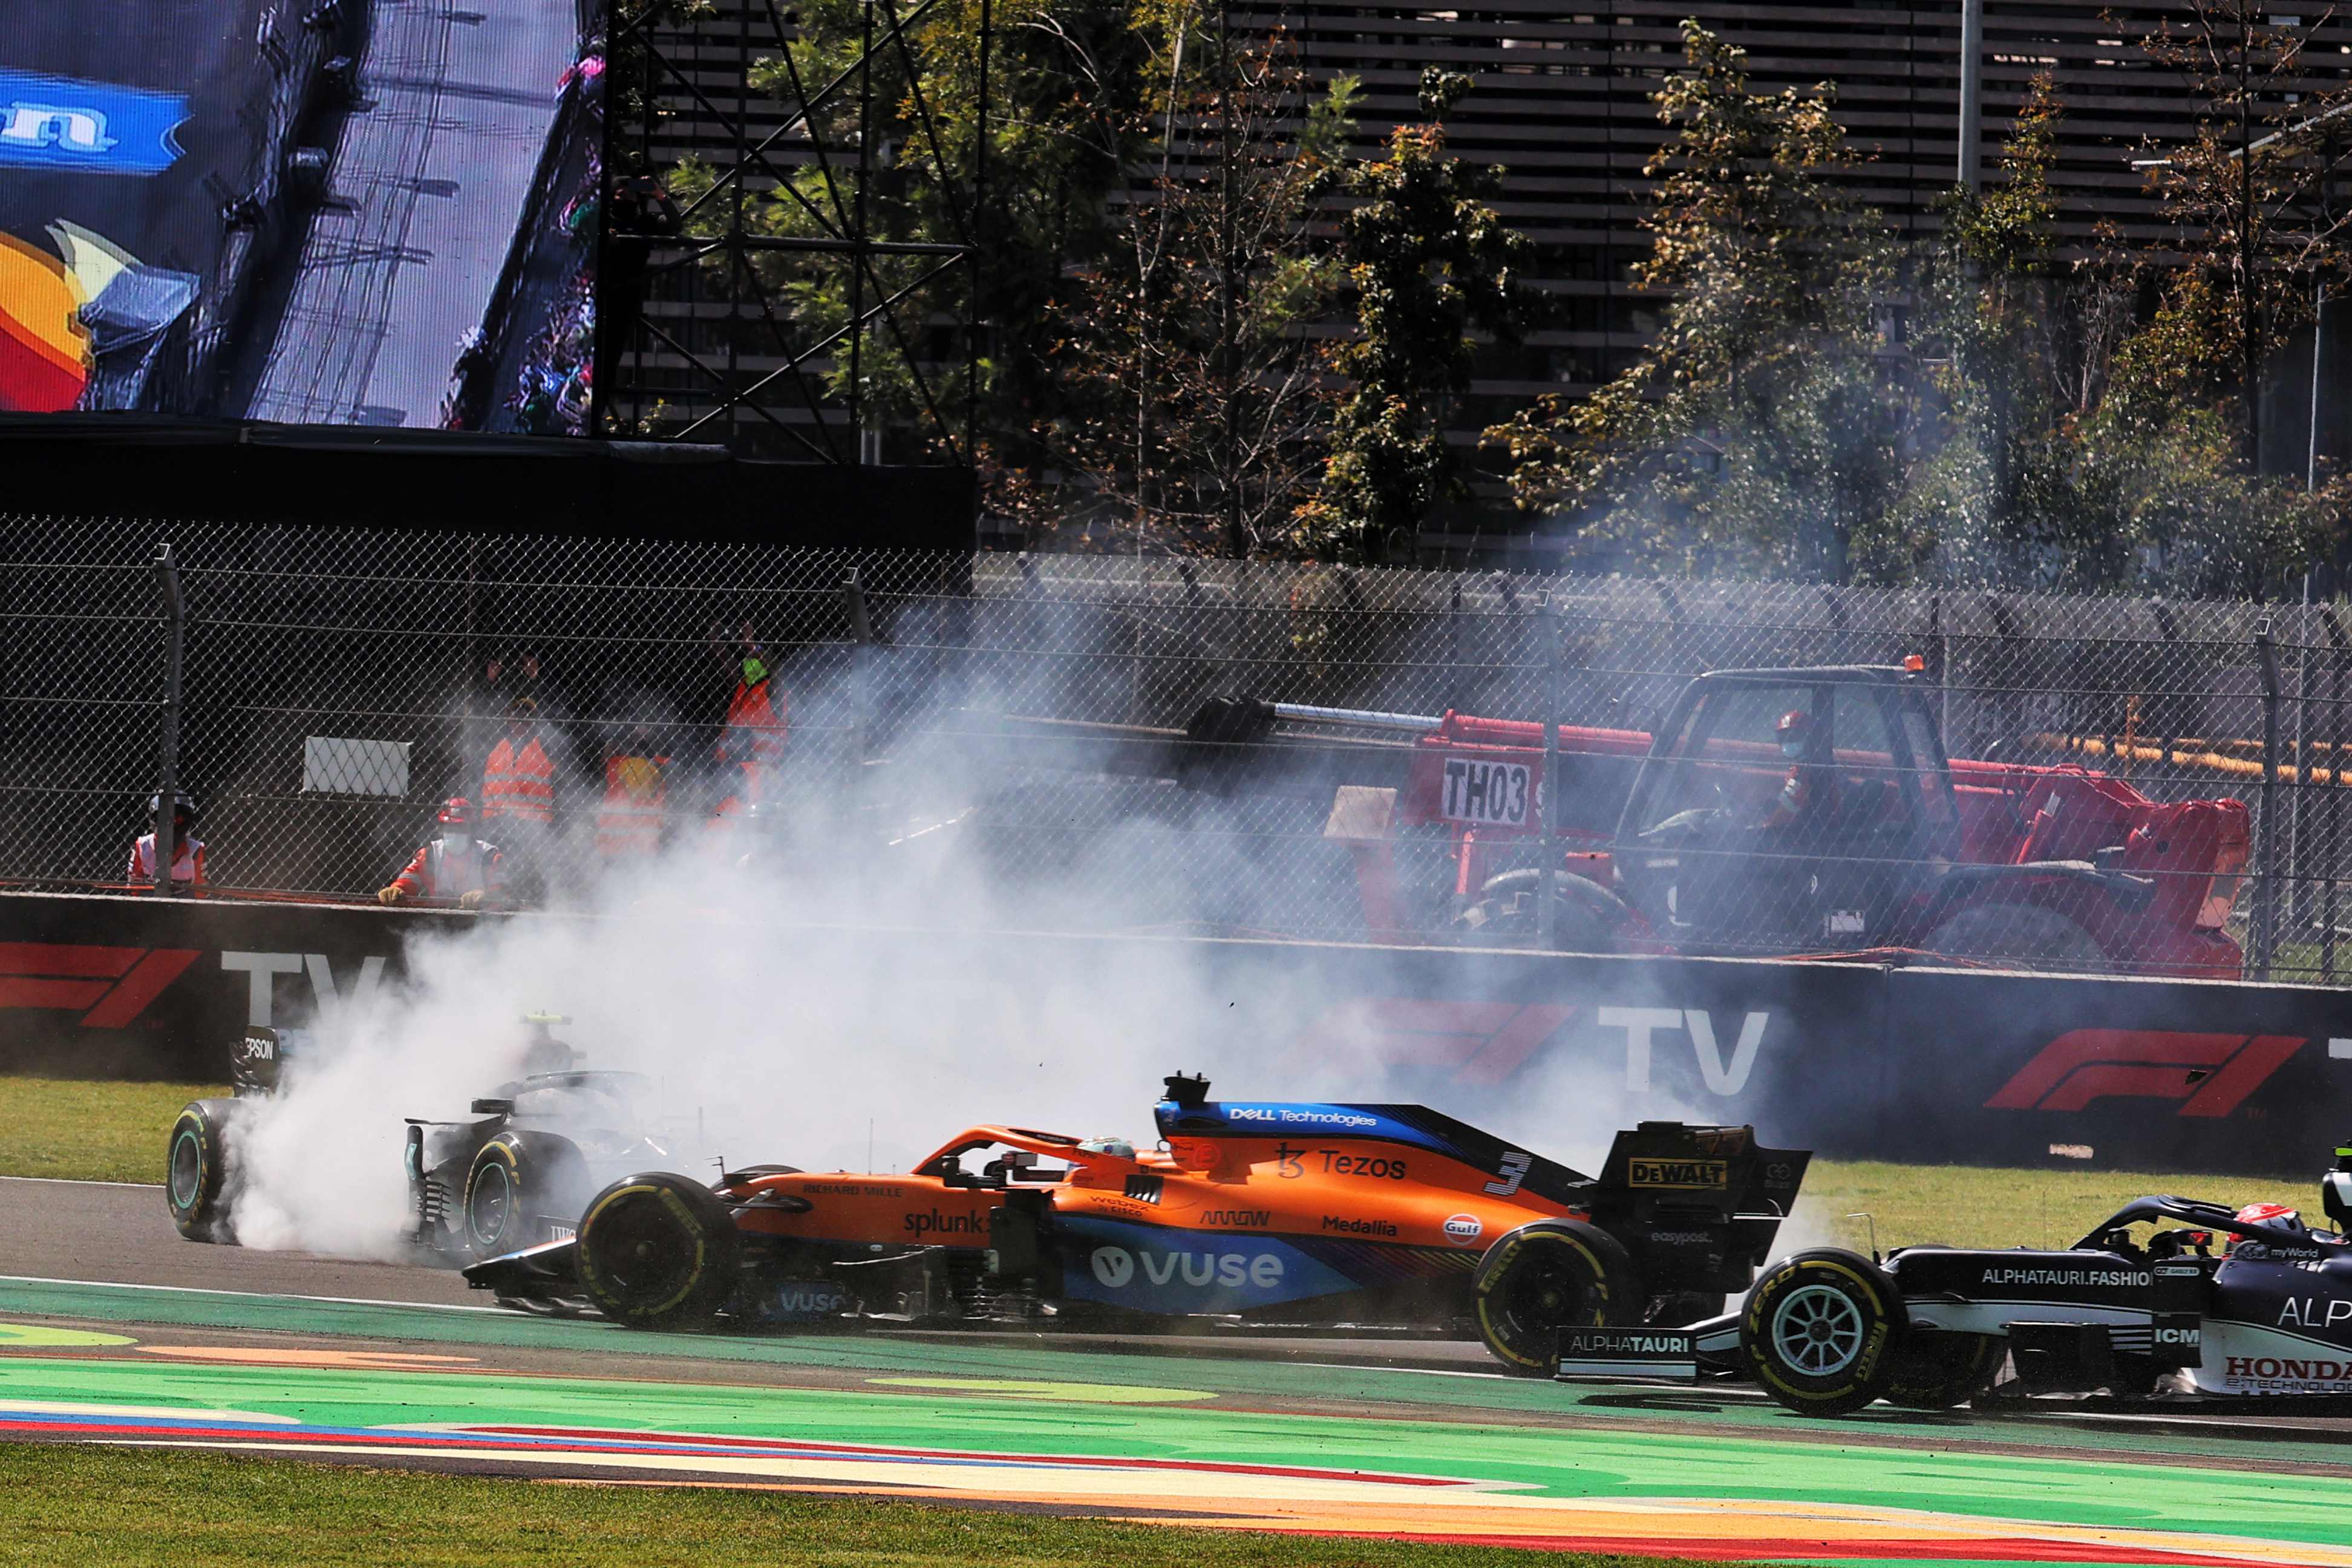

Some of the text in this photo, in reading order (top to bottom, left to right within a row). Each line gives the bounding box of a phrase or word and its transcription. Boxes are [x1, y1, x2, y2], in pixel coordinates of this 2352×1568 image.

[1445, 761, 1528, 823] TH03
[1598, 1006, 1770, 1096] TV
[1229, 1108, 1377, 1127] DELL Technologies
[1319, 1149, 1406, 1180] Tezos
[1483, 1151, 1533, 1197] 3
[803, 1183, 903, 1198] RICHARD MILLE
[1089, 1195, 1149, 1212] webex
[1323, 1216, 1397, 1237] Medallia
[1444, 1222, 1480, 1235] Gulf
[2270, 1247, 2319, 1258] myWorld
[1570, 1335, 1689, 1353] ALPHATAURI
[2155, 1328, 2200, 1343] ICM
